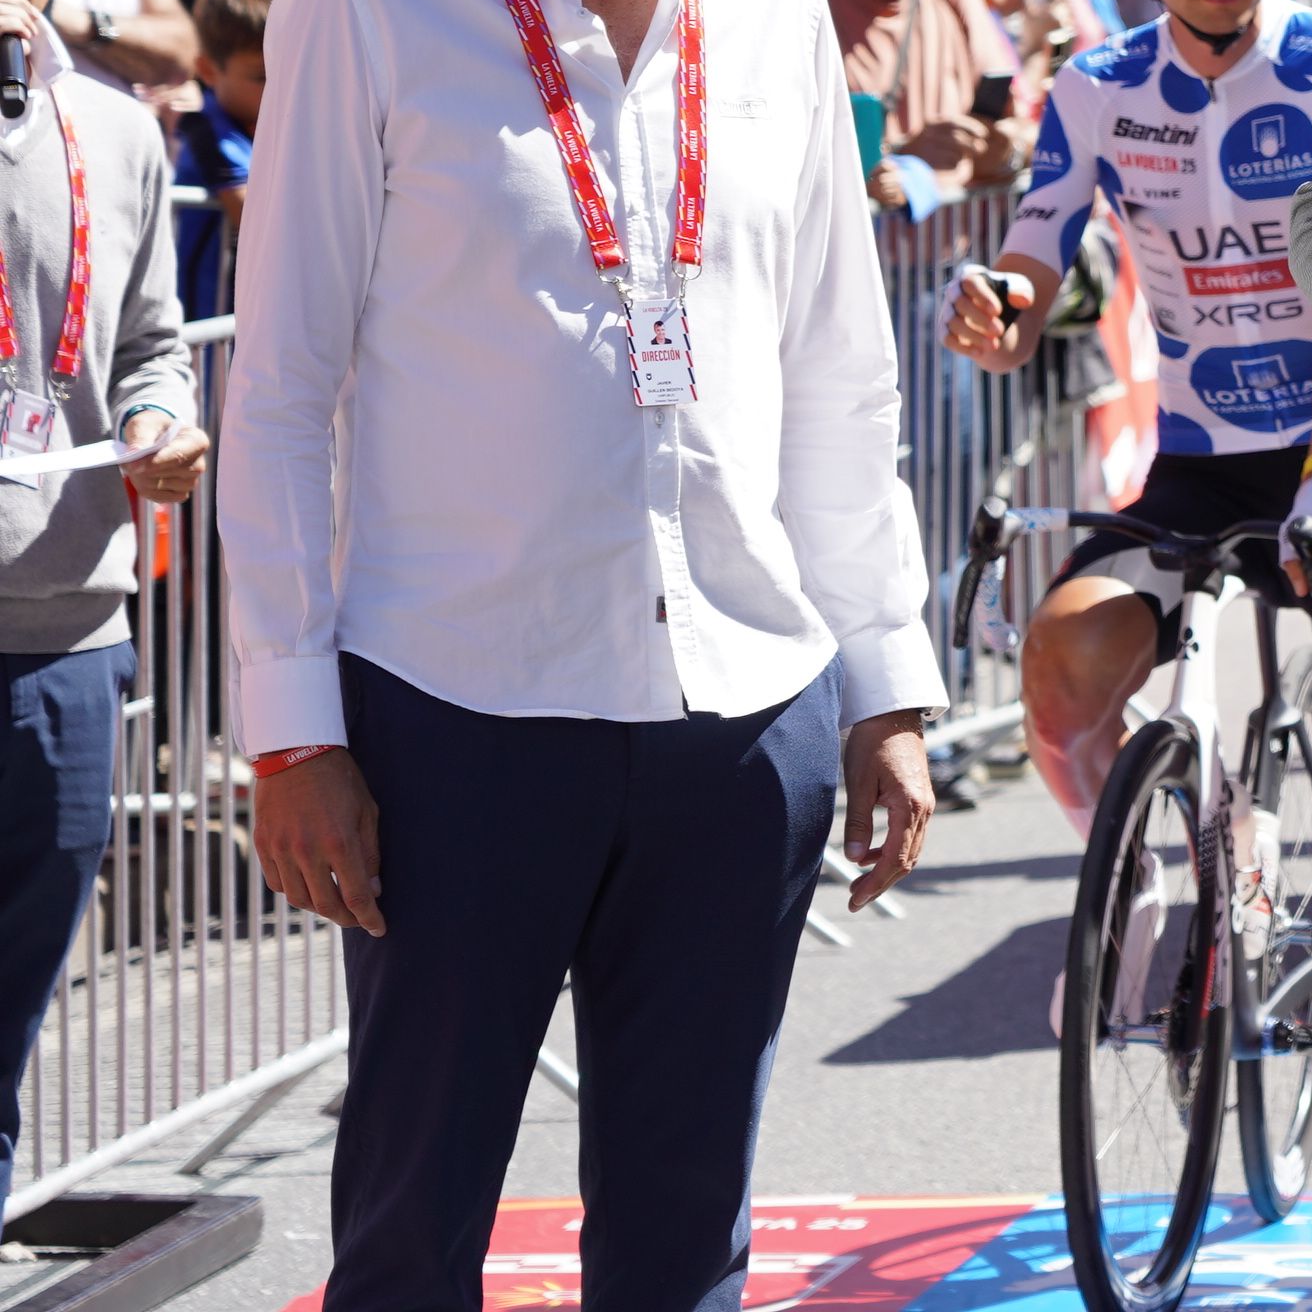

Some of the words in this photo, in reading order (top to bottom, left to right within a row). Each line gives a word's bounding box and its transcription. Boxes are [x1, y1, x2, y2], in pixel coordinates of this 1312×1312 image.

[1113, 117, 1200, 146] Santini
[1117, 152, 1132, 166] LA
[1132, 154, 1178, 173] VUELTA
[1169, 221, 1288, 261] UAE
[1194, 268, 1285, 291] Emirates
[1194, 296, 1304, 328] XRG
[642, 348, 680, 362] DIRECCIÓN
